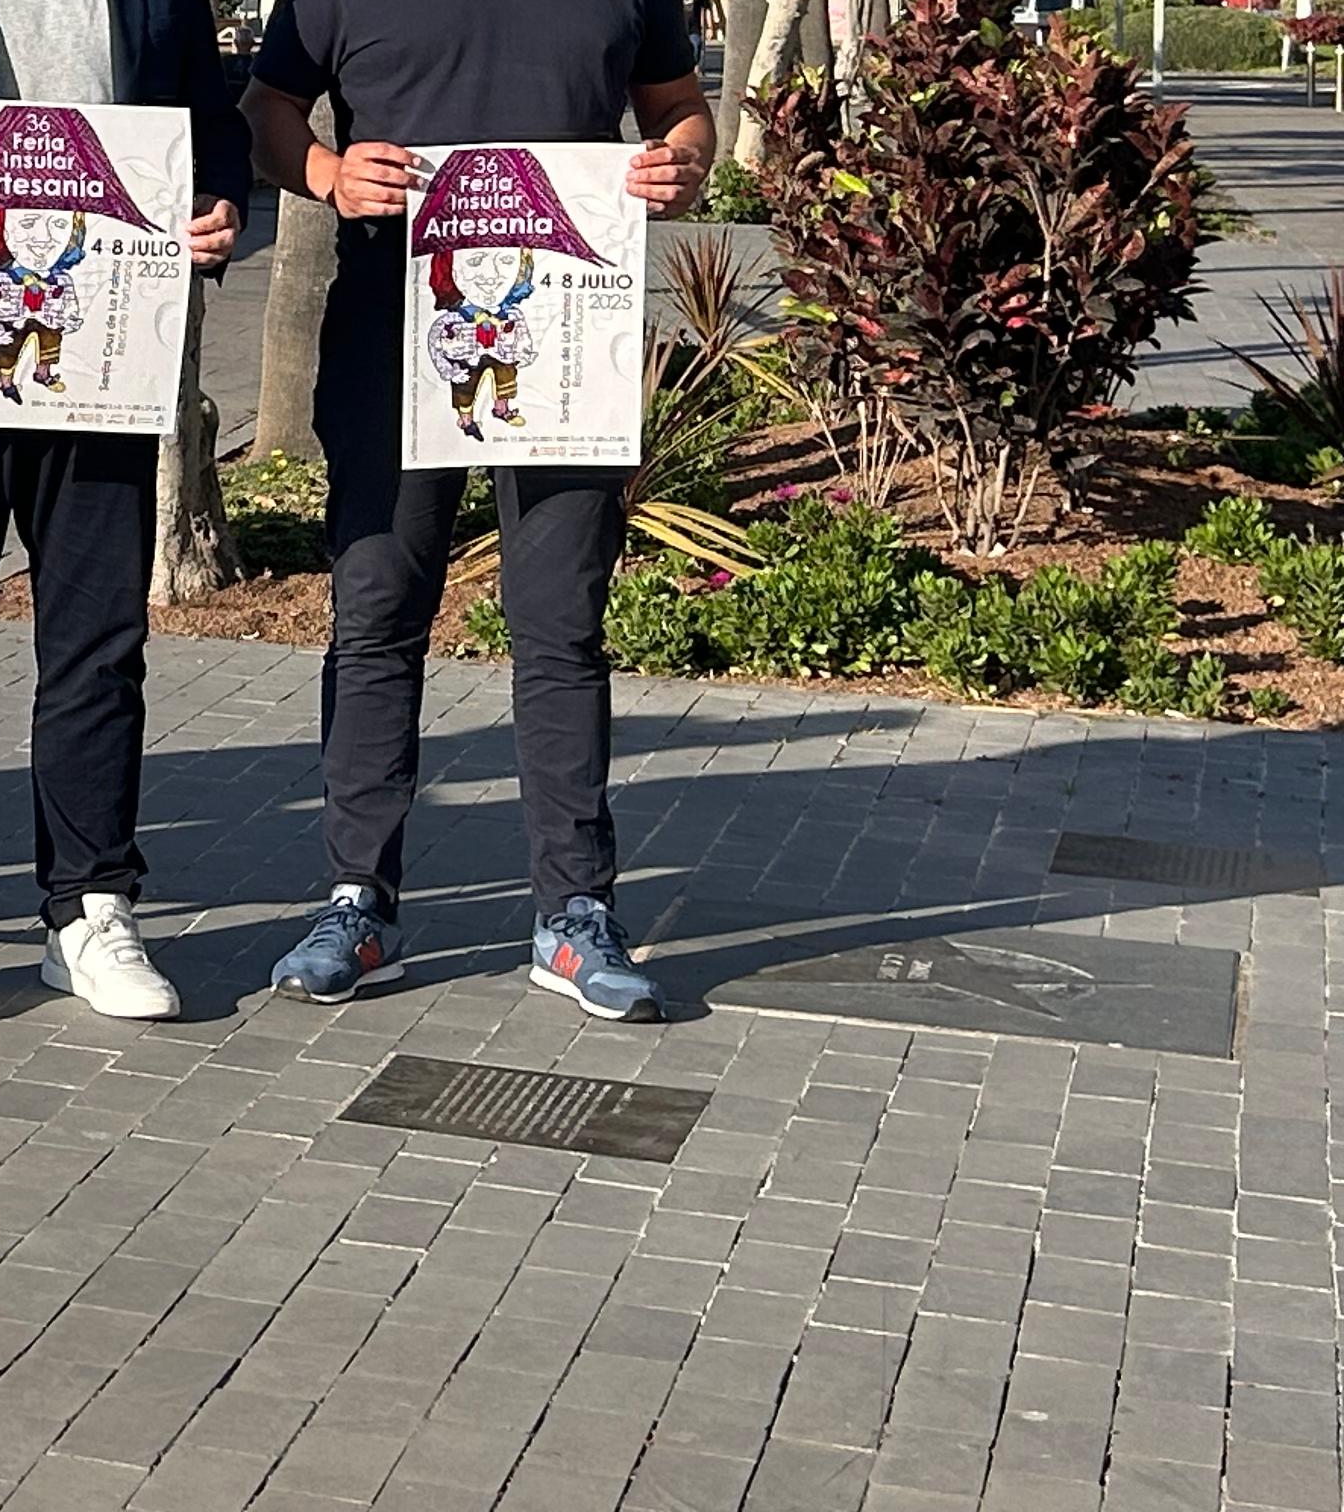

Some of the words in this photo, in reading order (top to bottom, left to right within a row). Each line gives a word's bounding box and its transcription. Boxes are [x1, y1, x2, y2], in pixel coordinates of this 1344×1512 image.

[26, 113, 50, 132] 36
[13, 132, 65, 152] Feria
[3, 150, 75, 170] Insular
[473, 155, 498, 173] 36
[460, 174, 512, 192] Feria
[451, 192, 523, 211] Insular
[423, 209, 552, 239] Artesanía
[127, 239, 181, 257] JULIO
[137, 260, 180, 279] 2025
[578, 273, 633, 289] JULIO
[588, 293, 633, 310] 2025
